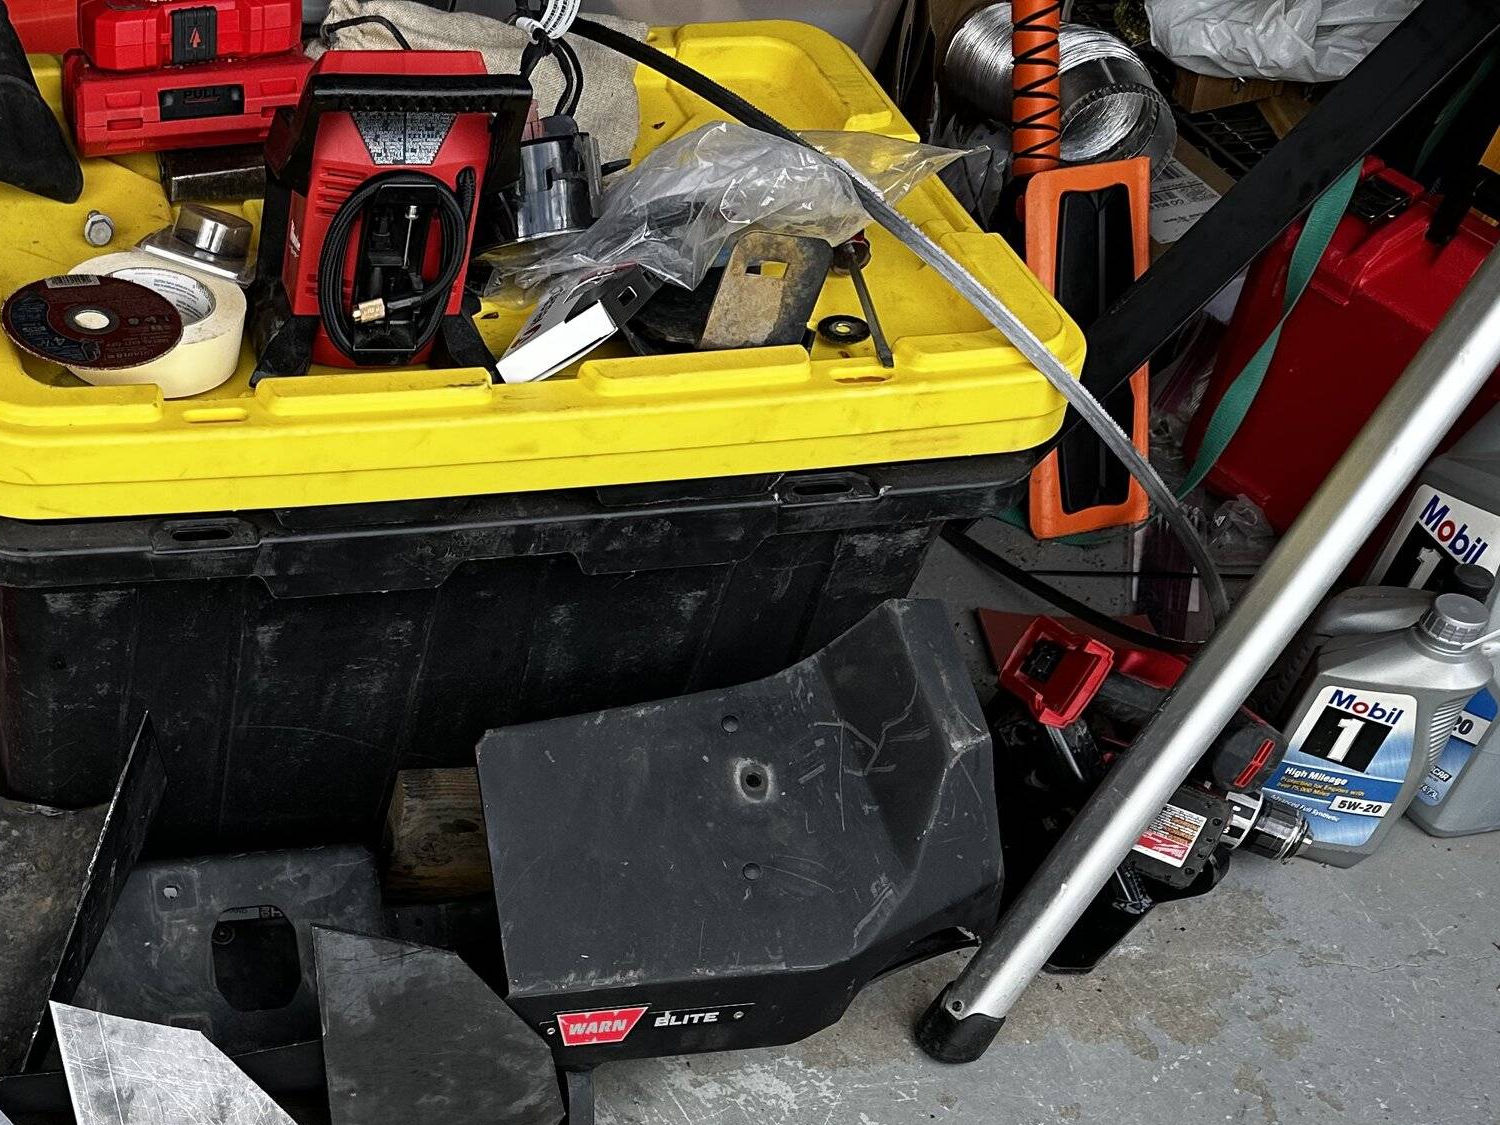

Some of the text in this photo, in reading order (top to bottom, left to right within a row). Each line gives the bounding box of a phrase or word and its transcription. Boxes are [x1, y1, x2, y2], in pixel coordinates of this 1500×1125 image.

[183, 87, 220, 99] PULL
[1419, 494, 1488, 565] Mobil
[1408, 547, 1443, 590] 1
[1328, 689, 1405, 725] Mobil
[1326, 717, 1366, 763] 1
[1285, 767, 1348, 787] High Mileage
[1338, 800, 1382, 814] 5W-20
[569, 1011, 720, 1036] WARN ELITE
